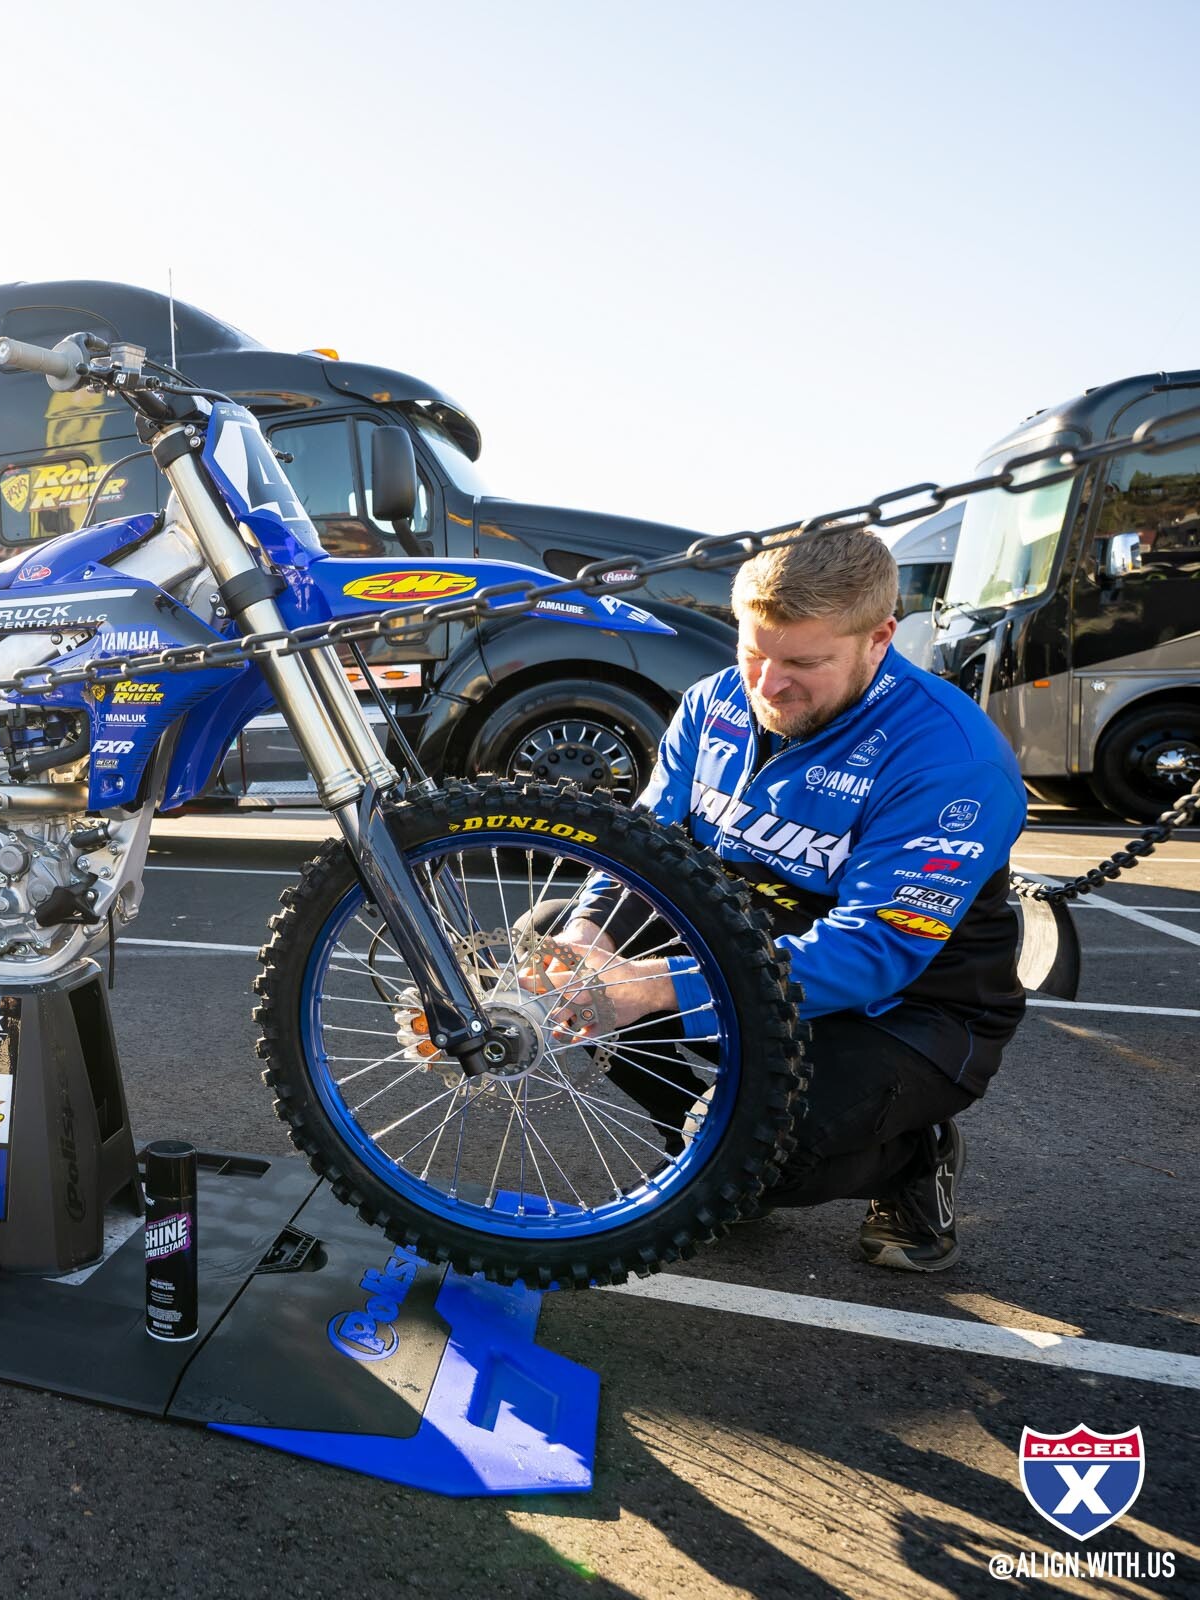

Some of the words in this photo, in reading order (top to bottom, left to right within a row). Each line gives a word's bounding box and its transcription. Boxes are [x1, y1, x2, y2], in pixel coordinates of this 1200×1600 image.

[344, 574, 477, 596] FMF
[74, 614, 108, 624] LLC
[101, 630, 159, 651] YAMAHA
[112, 691, 165, 704] RIVER
[113, 681, 161, 693] ROCK
[105, 713, 146, 723] MANLUK
[91, 740, 135, 754] FXR
[805, 784, 861, 804] RACIN
[822, 770, 875, 797] YAMAH
[460, 814, 599, 845] DUNLOP
[722, 837, 816, 878] RACING
[902, 836, 985, 859] FXR
[895, 895, 953, 916] WORKS
[898, 886, 958, 908] DECAL
[145, 1216, 188, 1250] SHINE
